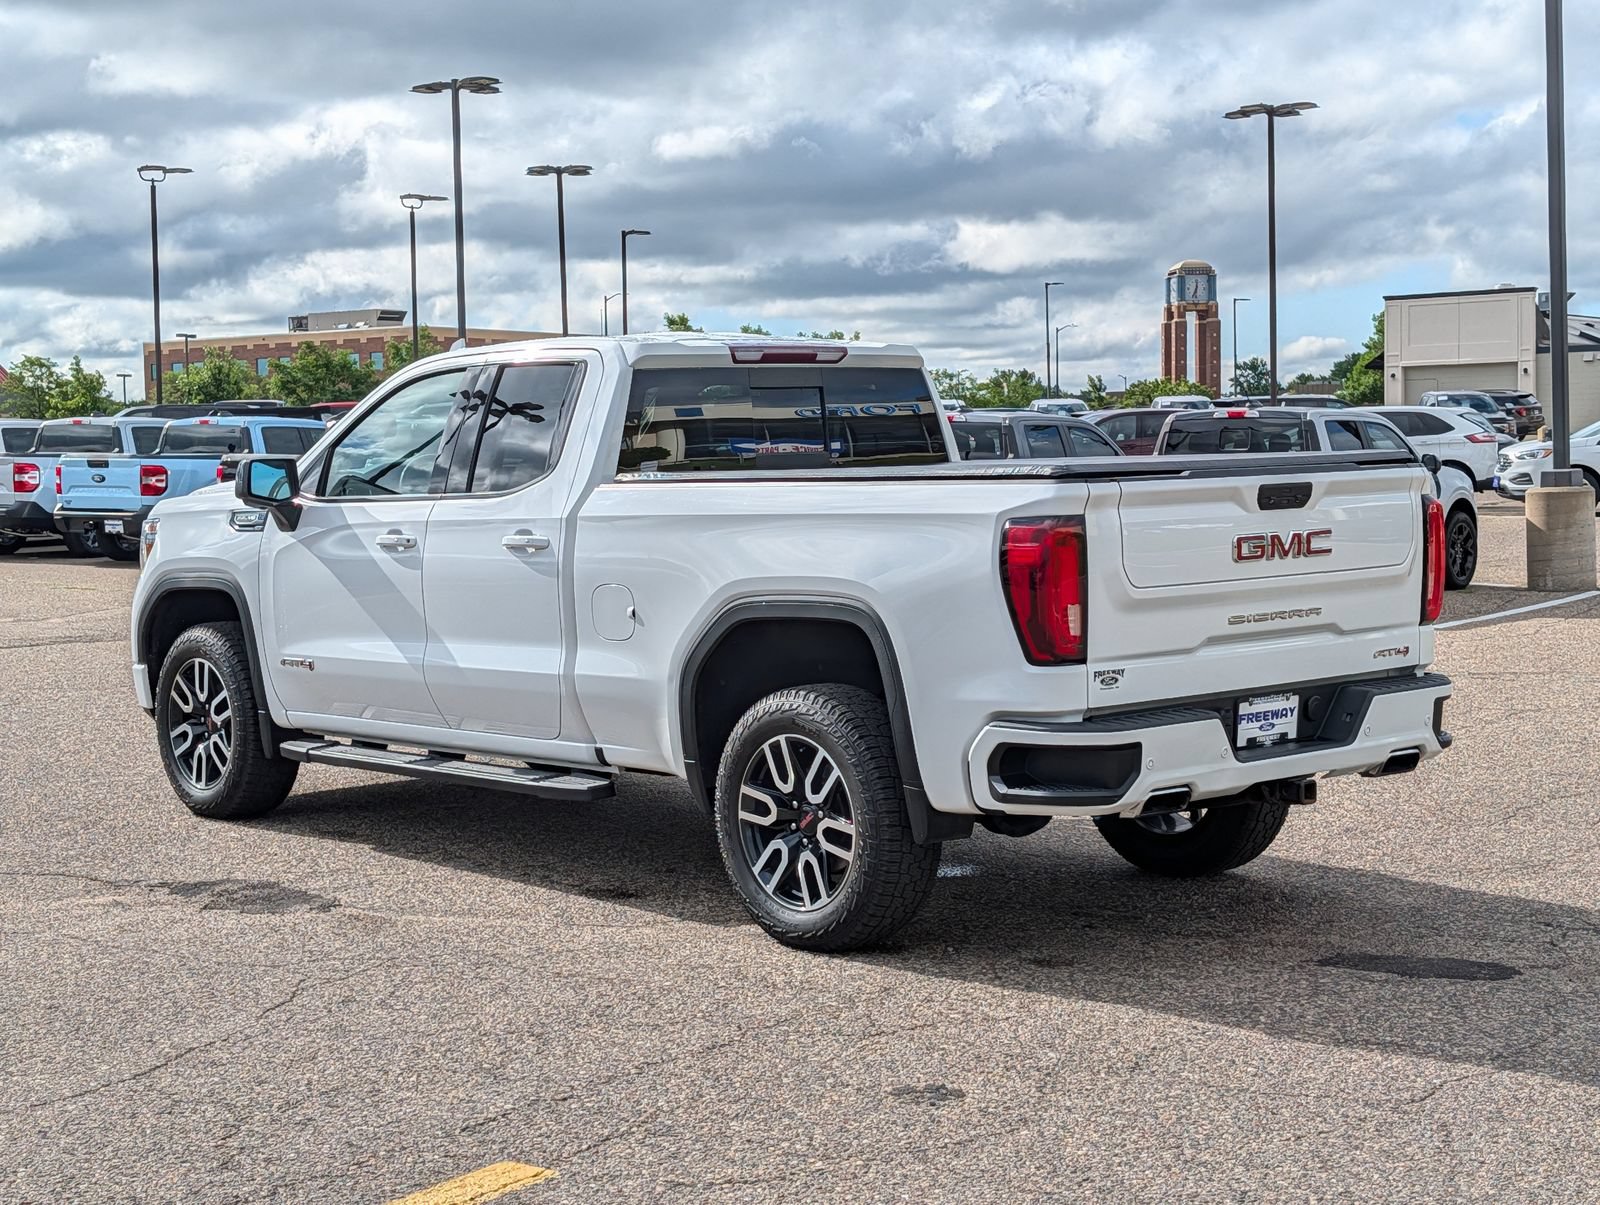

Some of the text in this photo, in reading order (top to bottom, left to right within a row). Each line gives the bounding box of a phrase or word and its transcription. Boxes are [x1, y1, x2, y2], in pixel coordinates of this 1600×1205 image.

[1232, 528, 1333, 563] GMC
[1227, 607, 1323, 626] SIERRA
[1093, 668, 1126, 682] FREEWAY
[1238, 706, 1296, 725] FREEWAY
